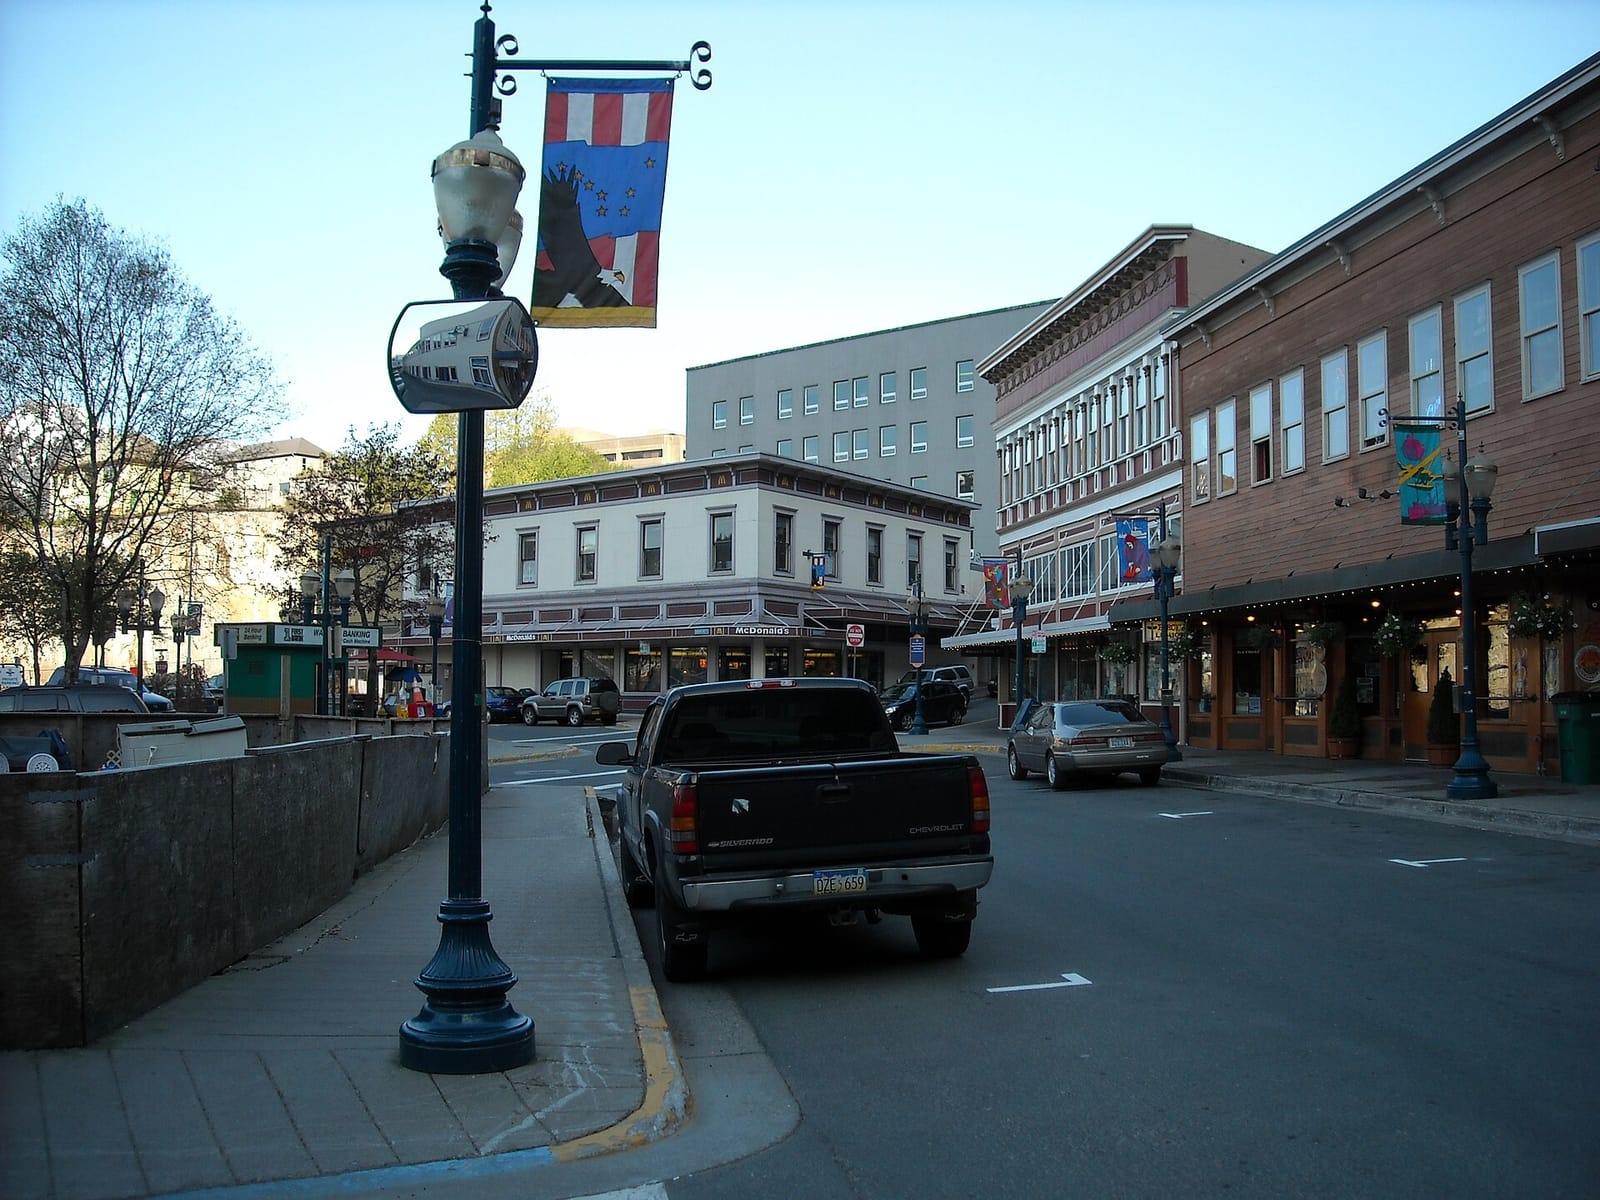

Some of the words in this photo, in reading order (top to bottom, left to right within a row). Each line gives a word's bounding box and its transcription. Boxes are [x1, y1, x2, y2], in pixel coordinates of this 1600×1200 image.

[343, 630, 370, 639] BANKING
[735, 627, 790, 635] McDonald's
[910, 823, 964, 834] CHEVROLET
[720, 838, 774, 848] SILVERADO
[845, 876, 864, 890] 659
